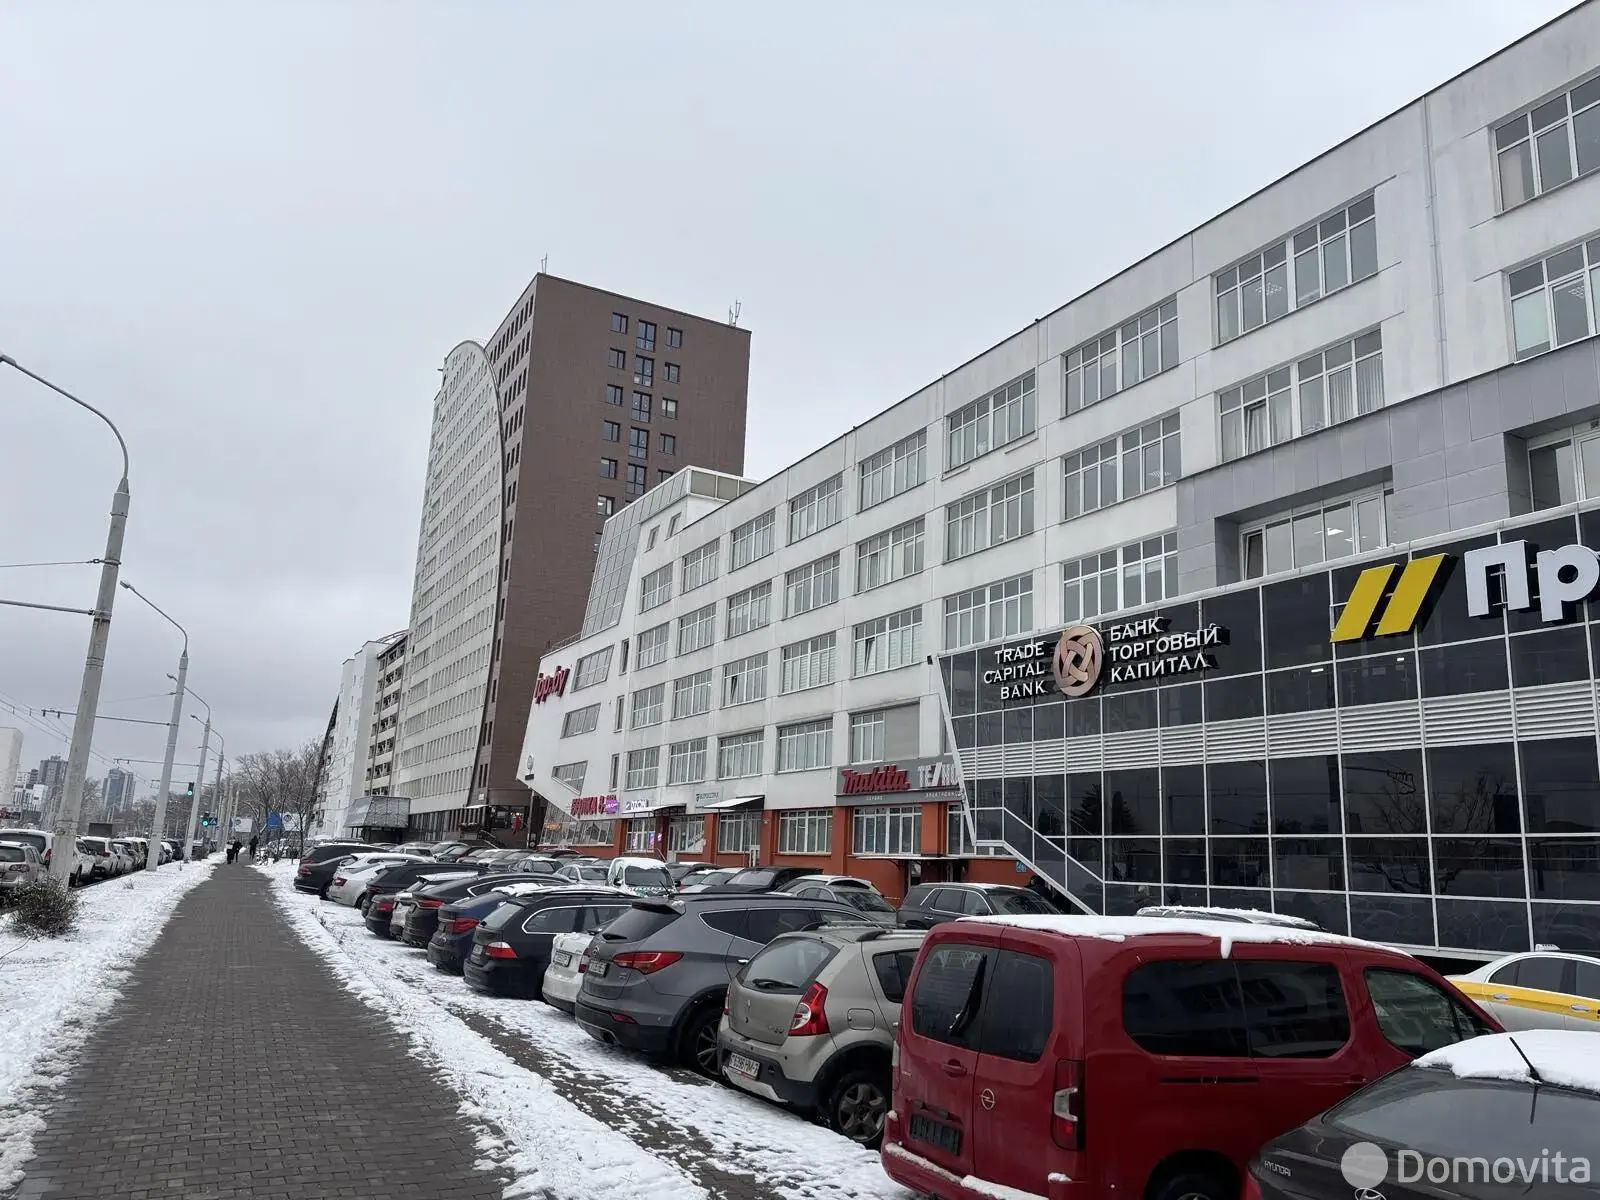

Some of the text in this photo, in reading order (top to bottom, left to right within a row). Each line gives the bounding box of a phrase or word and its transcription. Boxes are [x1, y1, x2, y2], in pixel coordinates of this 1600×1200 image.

[1109, 616, 1164, 643] БАНК
[1109, 622, 1222, 663] ТОРГОВЫЙ
[994, 641, 1046, 665] TRADE
[983, 659, 1046, 685] CAPITAL
[1110, 652, 1209, 684] КАПИТАЛ
[1000, 679, 1047, 701] BANK
[1263, 1160, 1292, 1177] HYUNDAI
